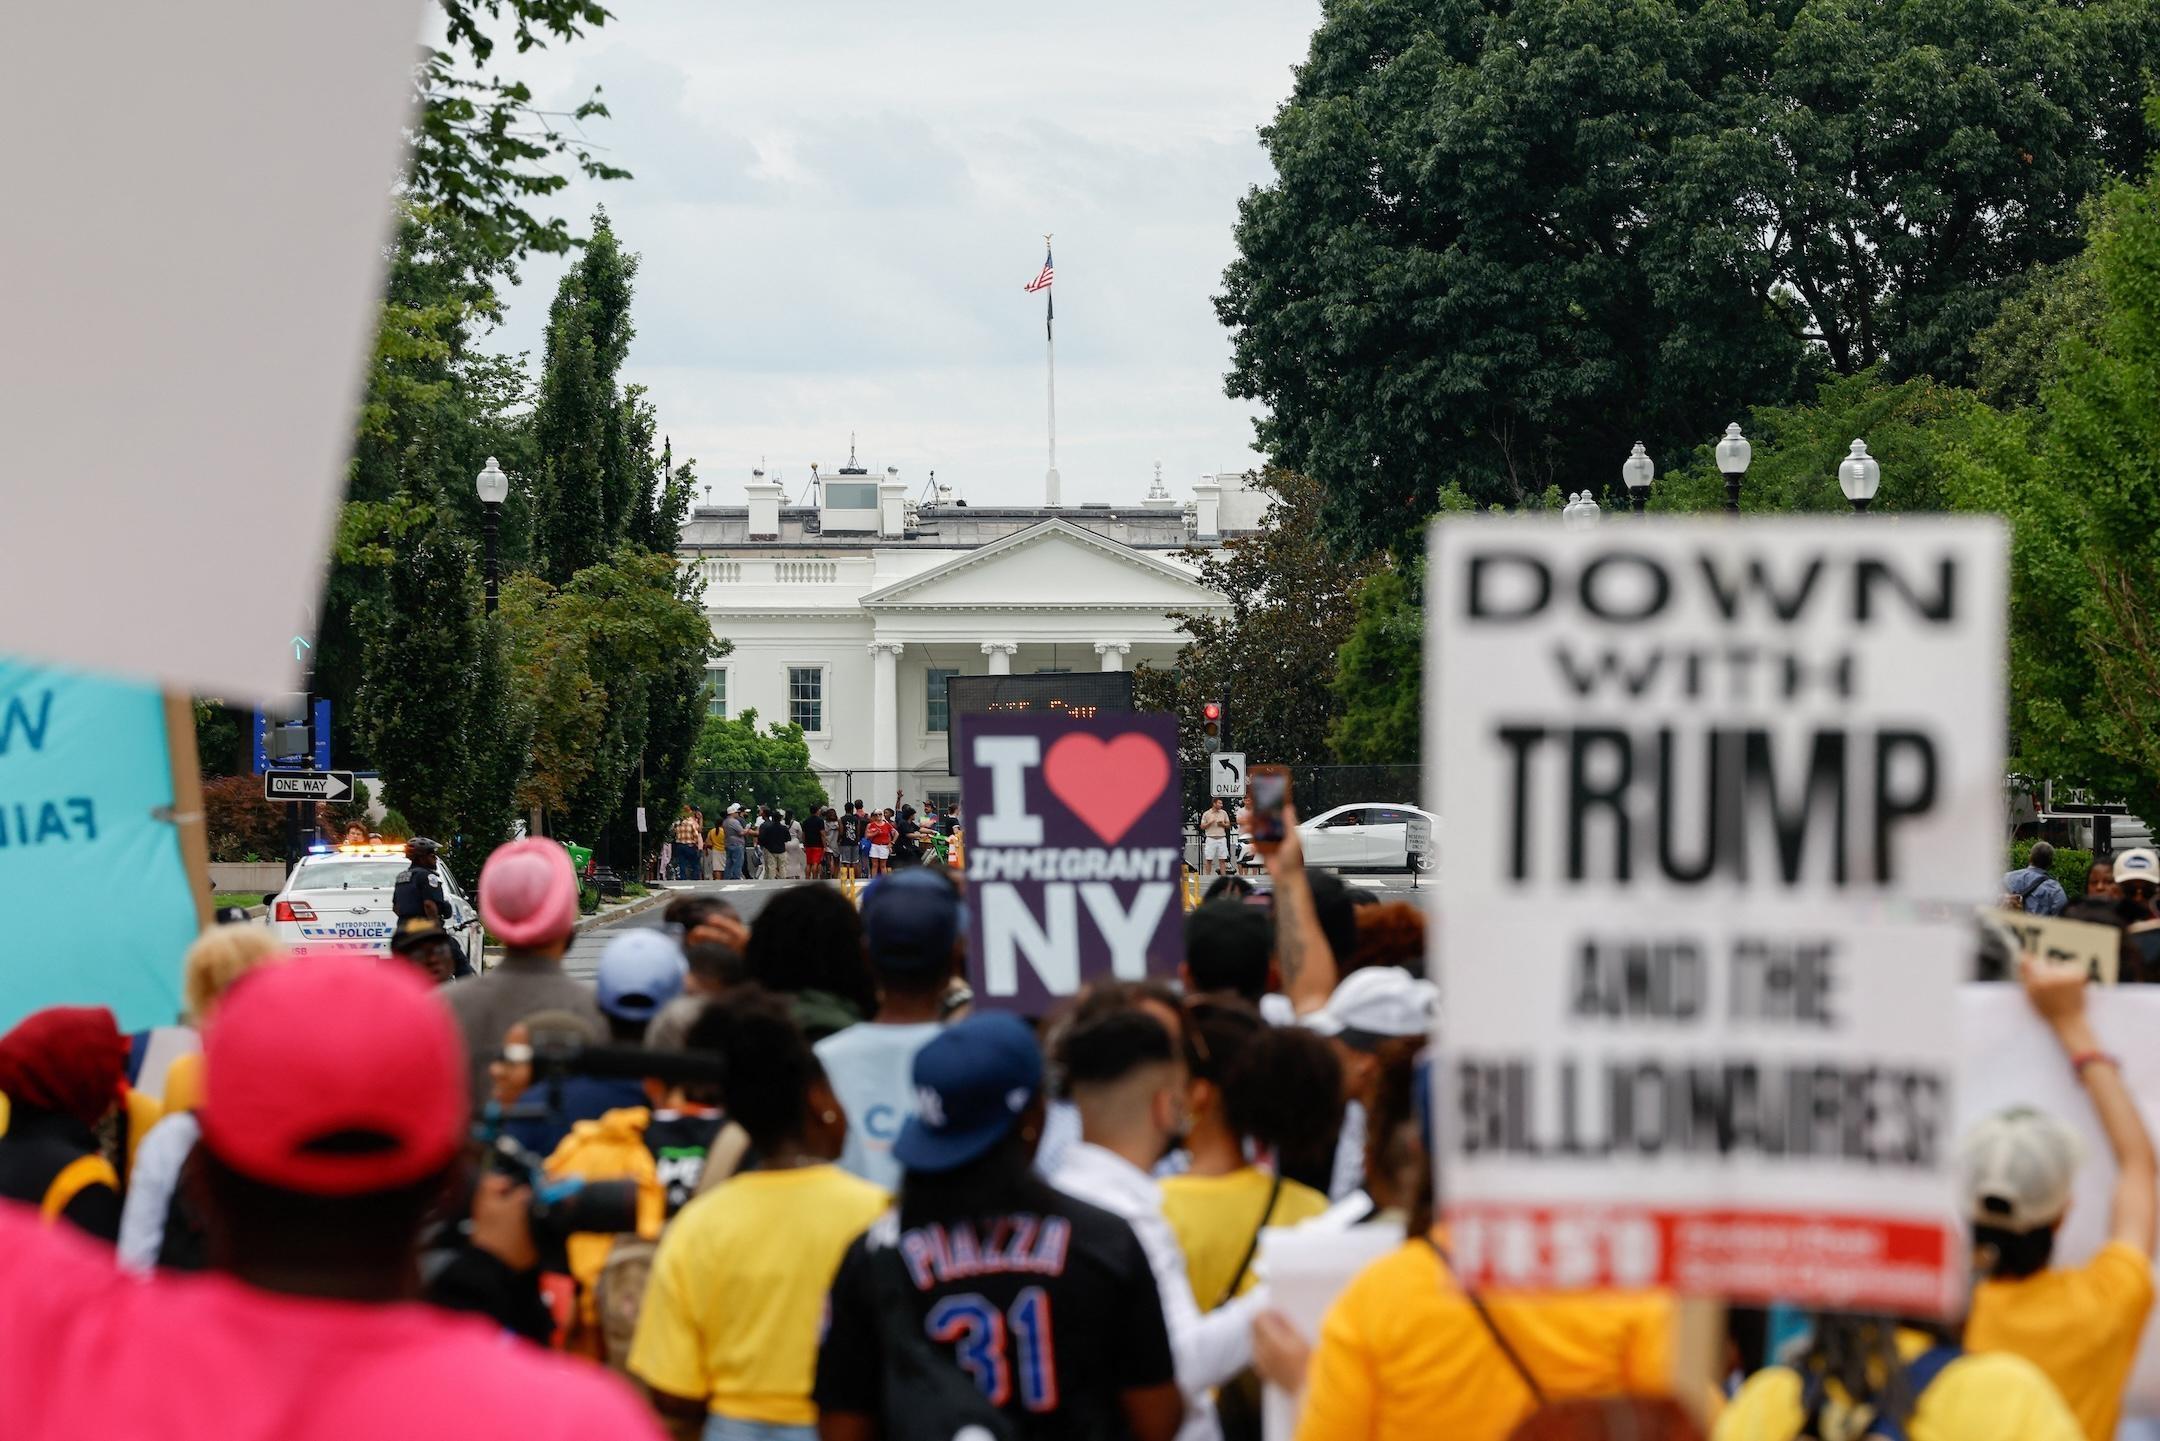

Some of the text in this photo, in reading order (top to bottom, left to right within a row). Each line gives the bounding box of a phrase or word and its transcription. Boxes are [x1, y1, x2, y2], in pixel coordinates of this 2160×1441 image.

[1465, 551, 1956, 622] DOWN
[1554, 642, 1854, 698] WITH
[275, 780, 326, 792] ONE WAY
[973, 736, 1043, 845] I
[1216, 784, 1240, 793] ONLY
[1496, 727, 1940, 886] TRUMP
[968, 848, 1177, 880] IMMIGRANT
[336, 921, 387, 929] METROPOLITAN
[338, 928, 383, 937] POLICE
[981, 882, 1174, 996] NY
[1571, 937, 1838, 1024] AND THE
[1459, 1061, 1948, 1164] BILLIONAIRES
[900, 1212, 1071, 1290] PIAZZA
[925, 1286, 1059, 1412] 31
